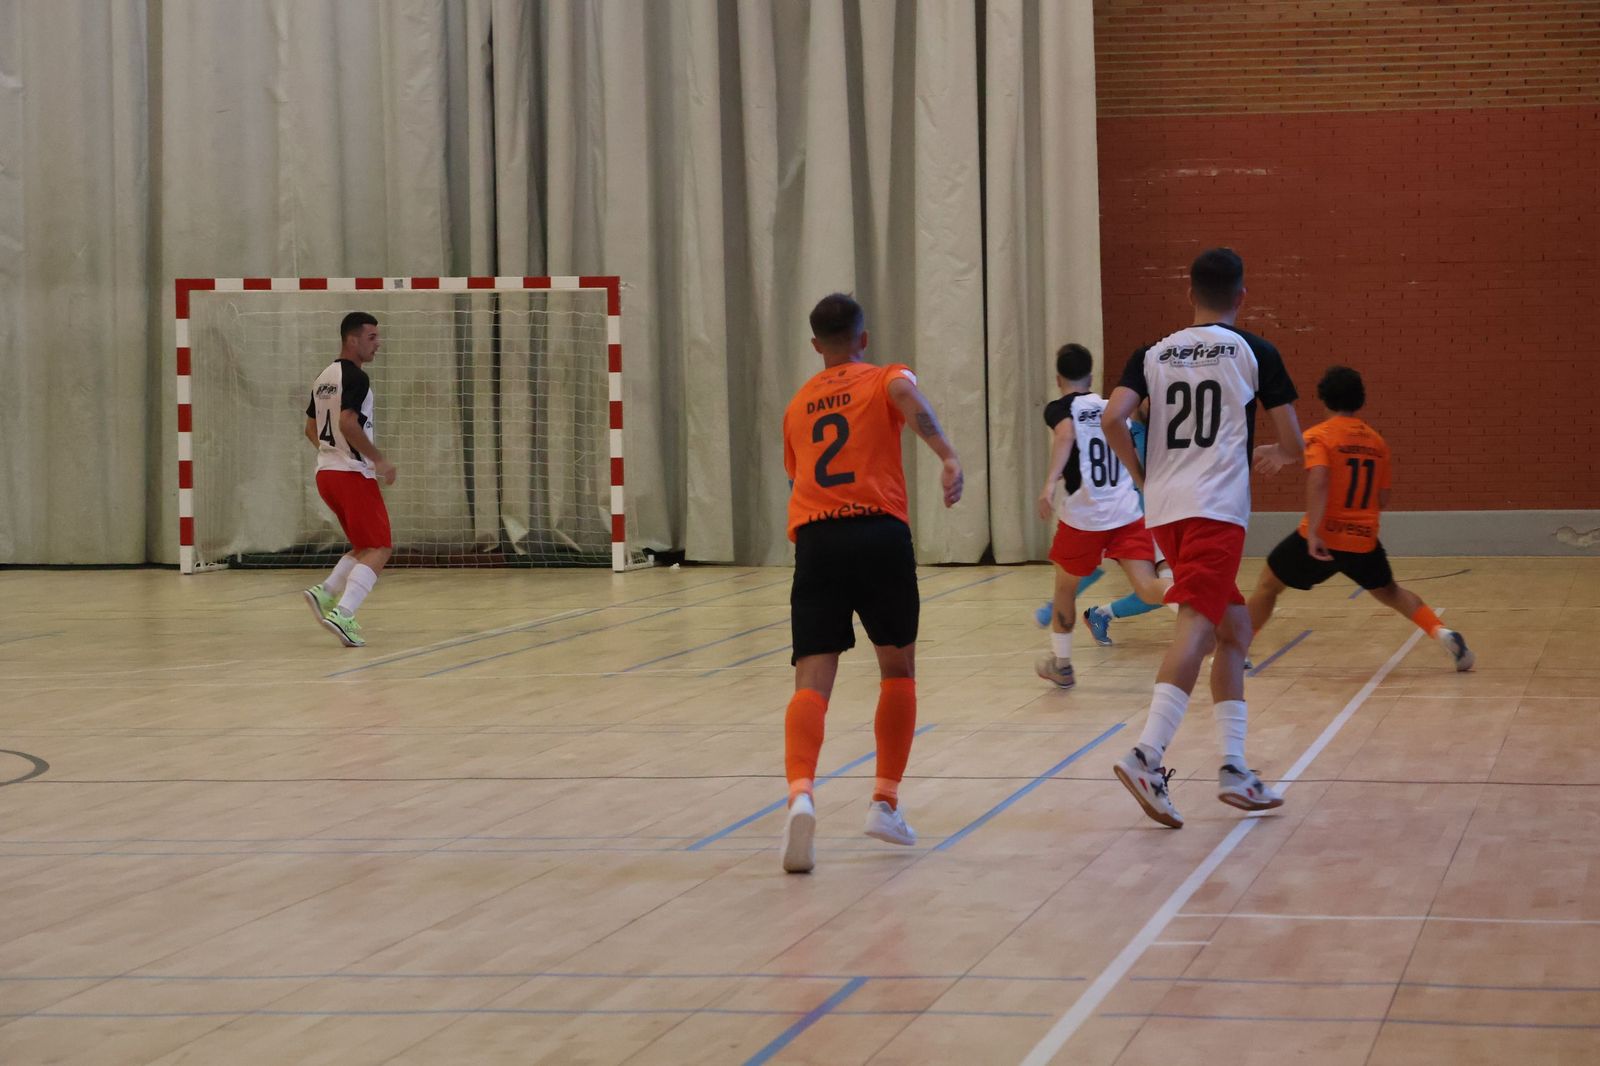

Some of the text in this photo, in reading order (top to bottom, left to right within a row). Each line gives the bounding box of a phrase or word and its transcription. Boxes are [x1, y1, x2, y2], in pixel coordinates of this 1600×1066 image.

[319, 409, 336, 447] 4
[807, 393, 851, 414] DAVID
[1166, 380, 1221, 449] 20
[812, 413, 855, 488] 2
[1089, 438, 1119, 487] 80
[1344, 458, 1376, 510] 11
